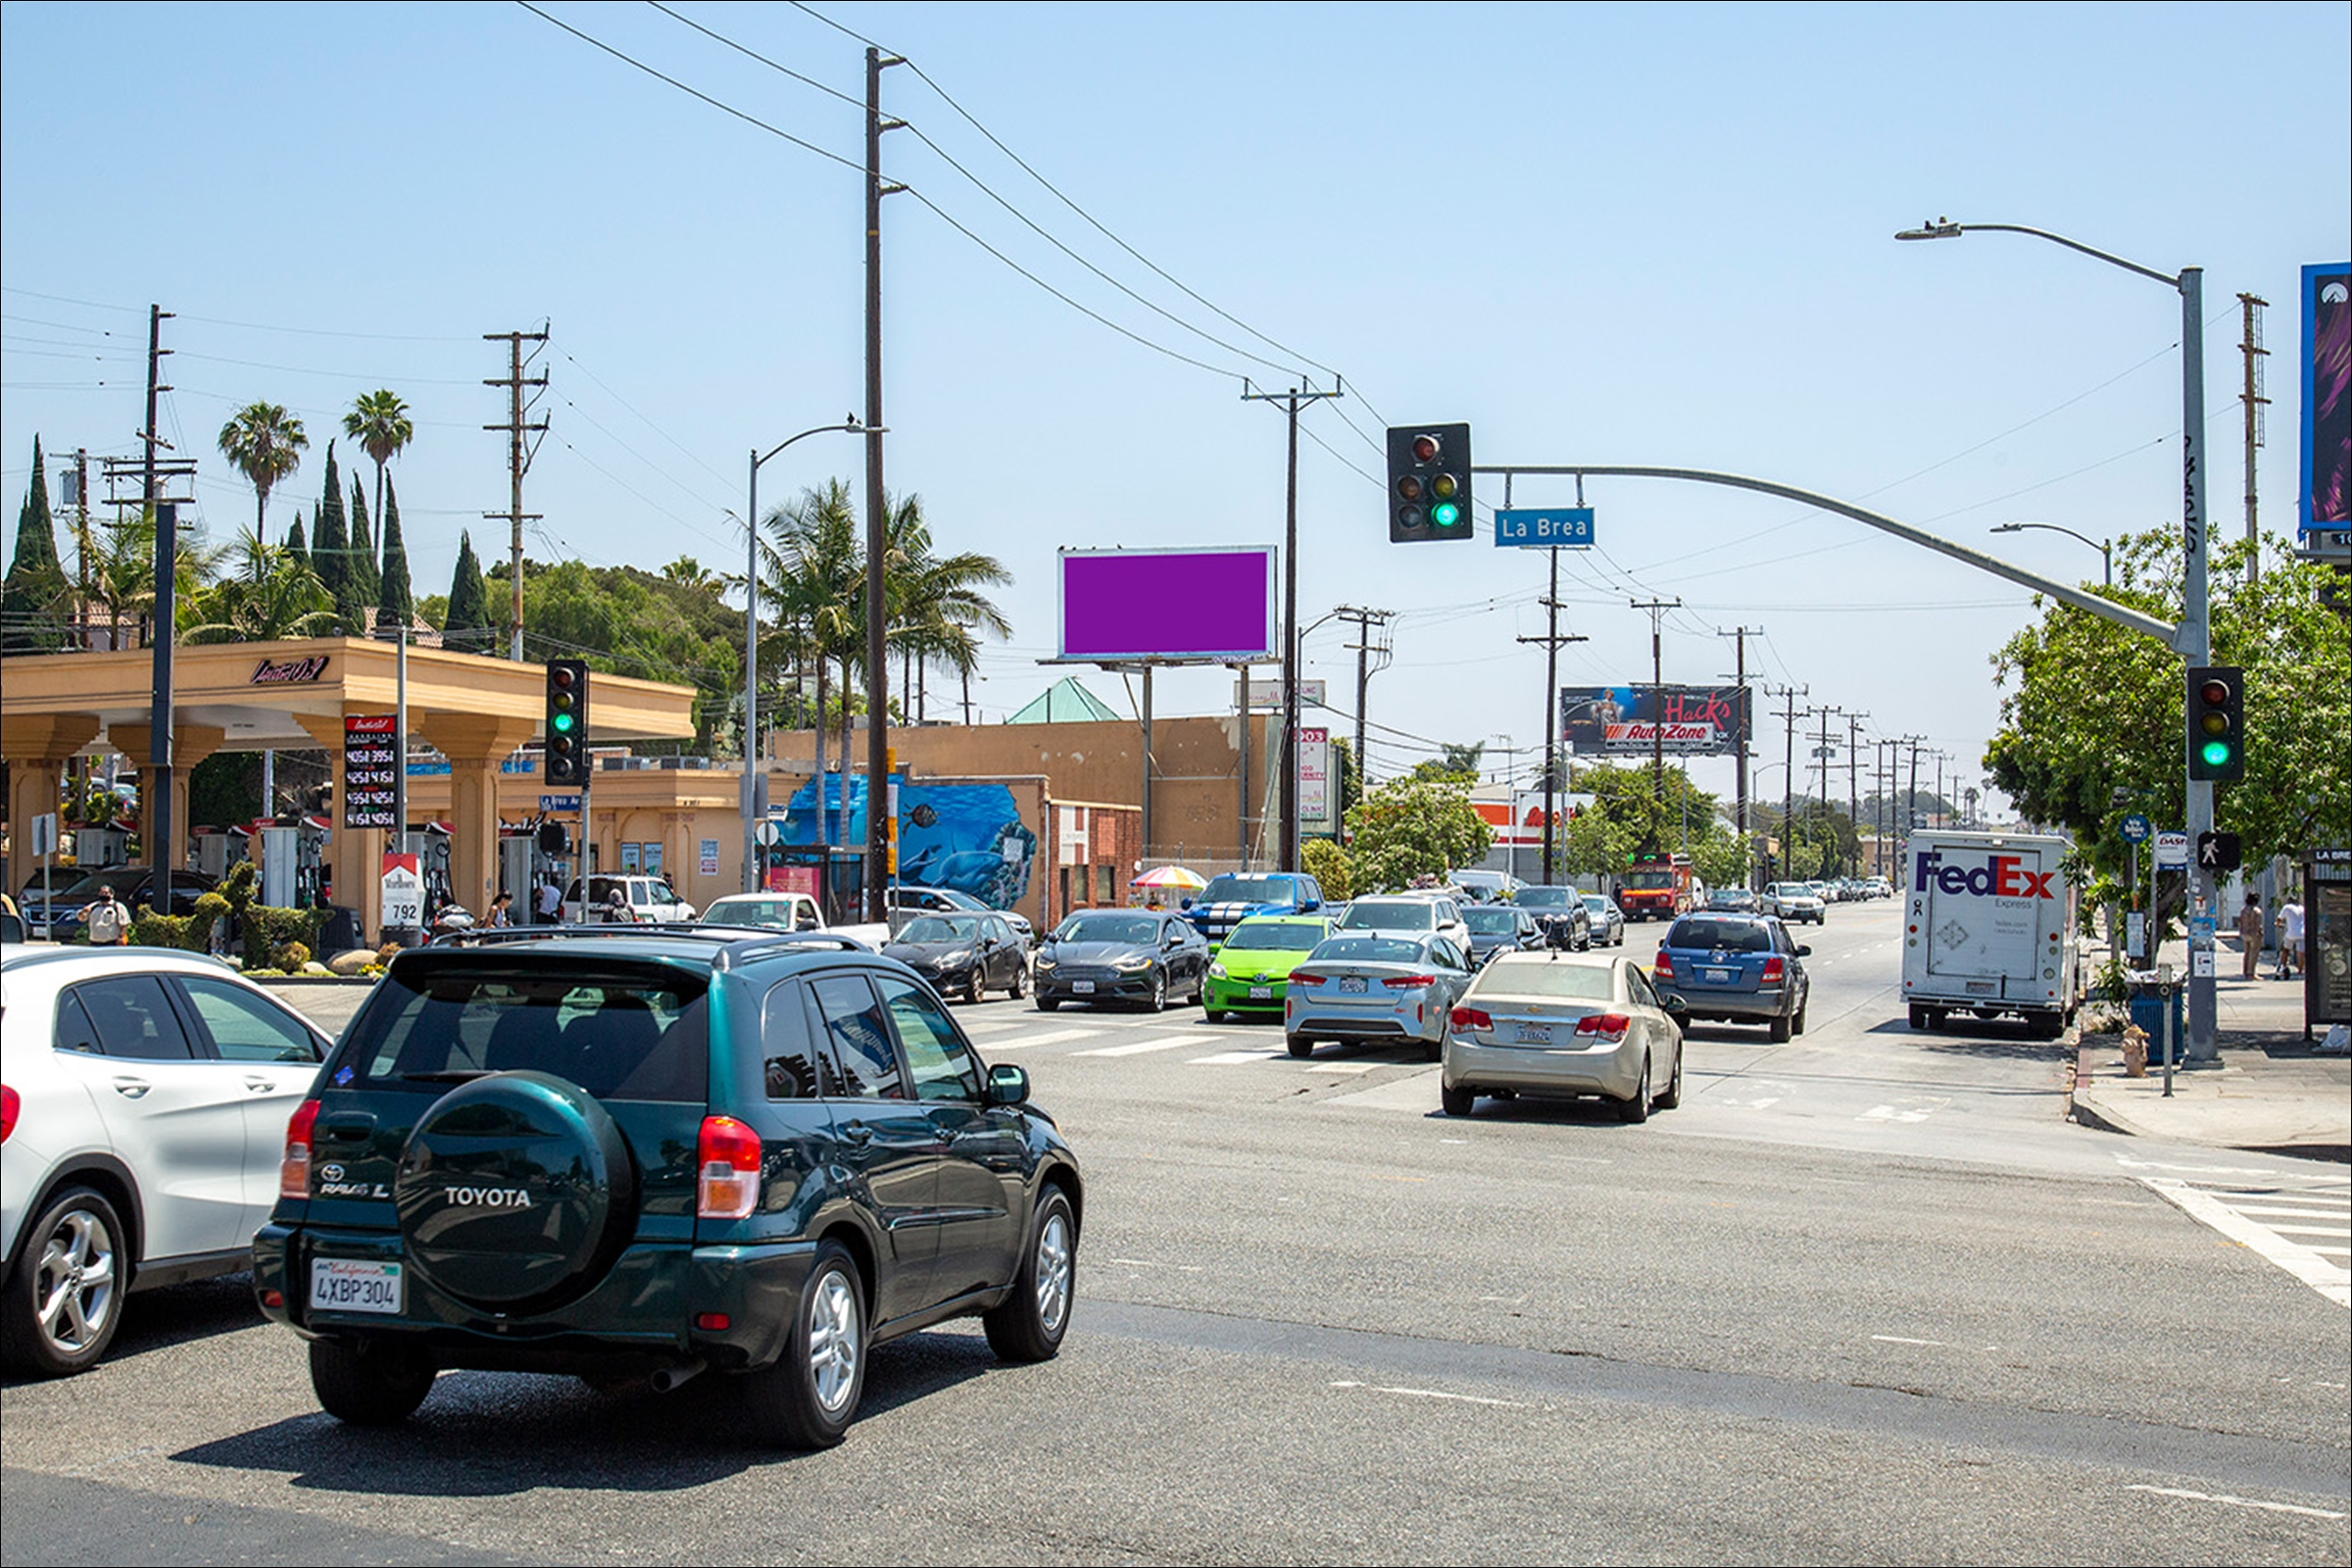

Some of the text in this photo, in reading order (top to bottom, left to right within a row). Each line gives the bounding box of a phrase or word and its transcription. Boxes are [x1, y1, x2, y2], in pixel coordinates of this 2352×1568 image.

[1503, 518, 1587, 537] La Brea
[1664, 692, 1731, 731] Hacks
[1627, 725, 1707, 740] AutoZone
[2316, 851, 2351, 860] LA BRE
[1916, 852, 2056, 900] FedEx
[393, 905, 416, 919] 792
[1995, 899, 2033, 908] Express
[372, 1184, 390, 1198] L
[444, 1187, 531, 1207] TOYOTA
[317, 1277, 394, 1305] 4XBP304
